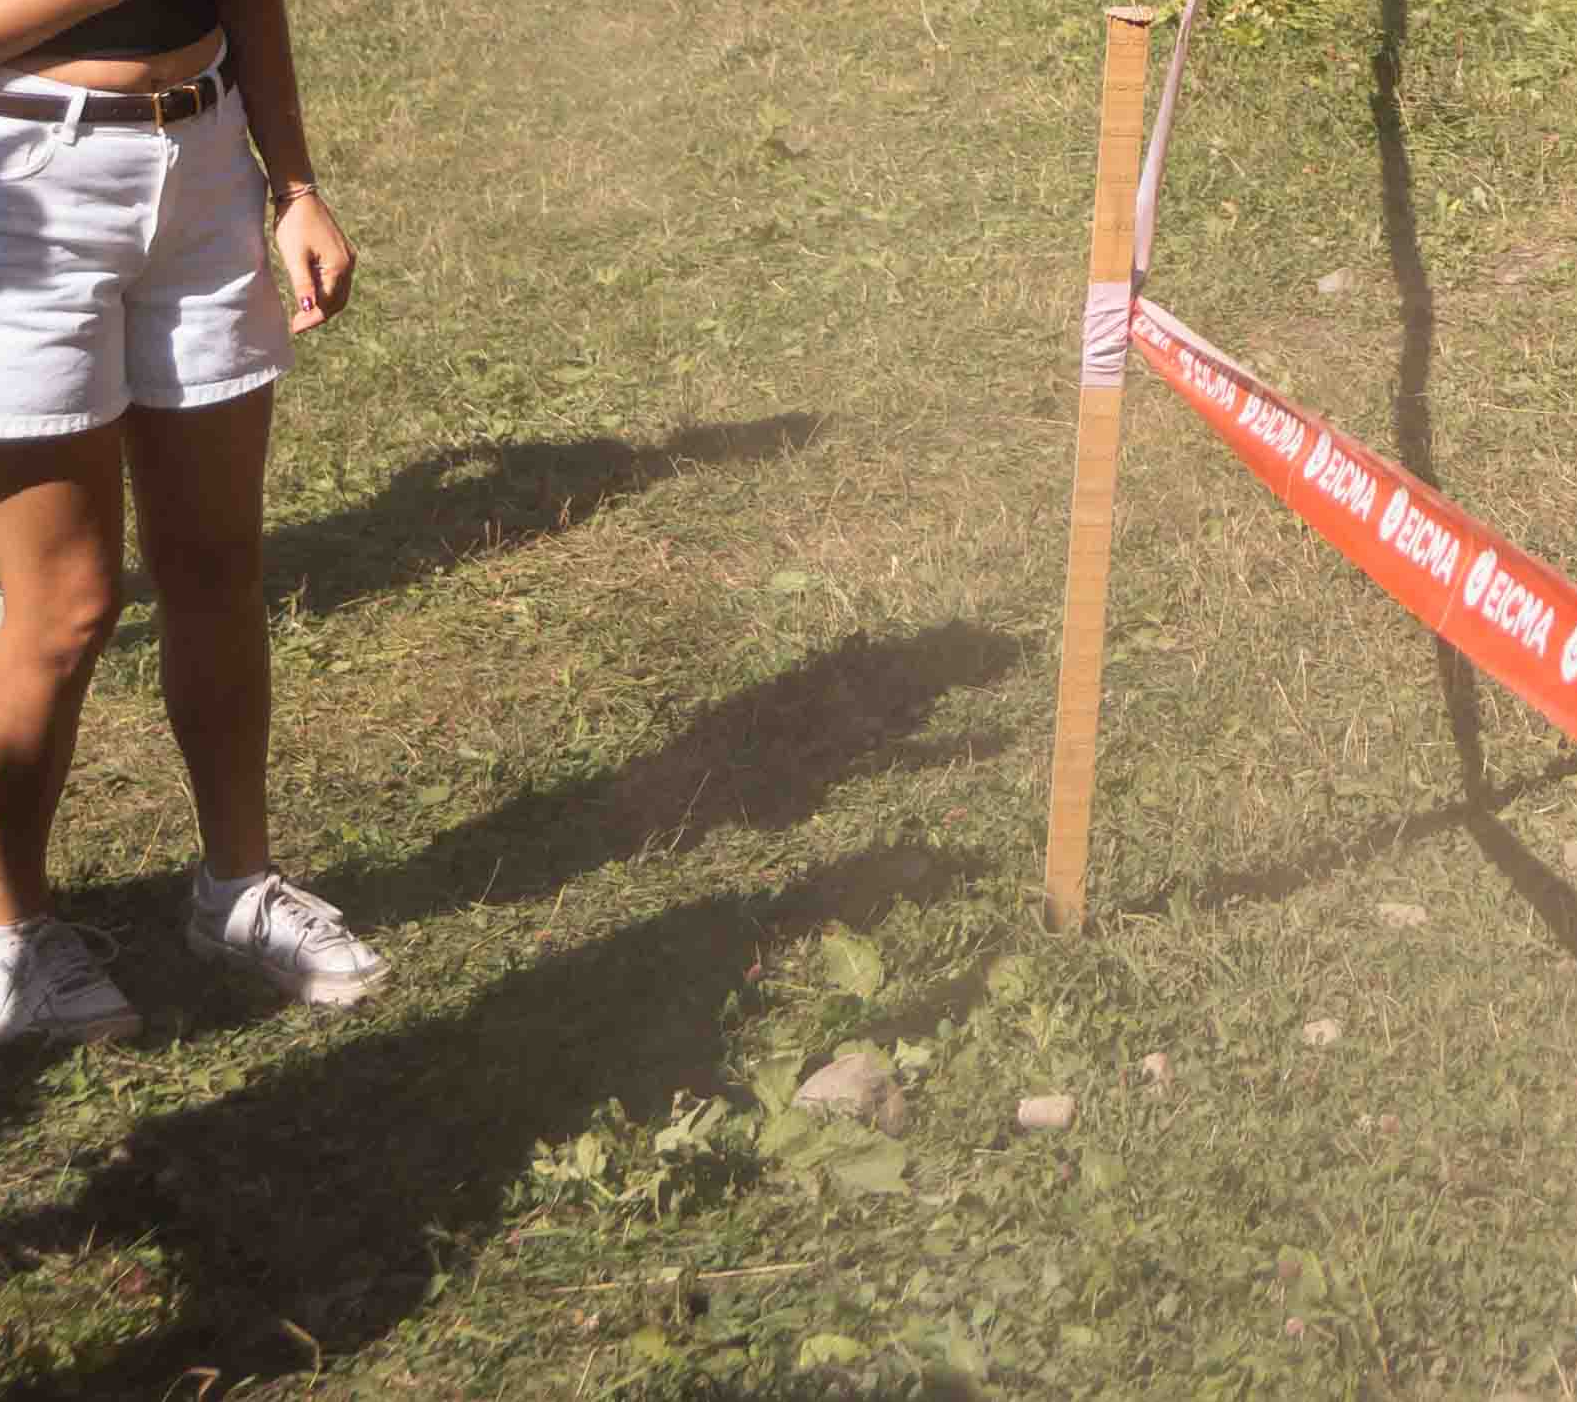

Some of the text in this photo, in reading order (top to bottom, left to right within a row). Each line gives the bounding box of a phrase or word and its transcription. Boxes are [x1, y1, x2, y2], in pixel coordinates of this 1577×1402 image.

[1249, 401, 1305, 461] EICMA
[1318, 449, 1377, 522] EICMA
[1395, 506, 1460, 586] EICMA
[1481, 570, 1554, 657] EICMA
